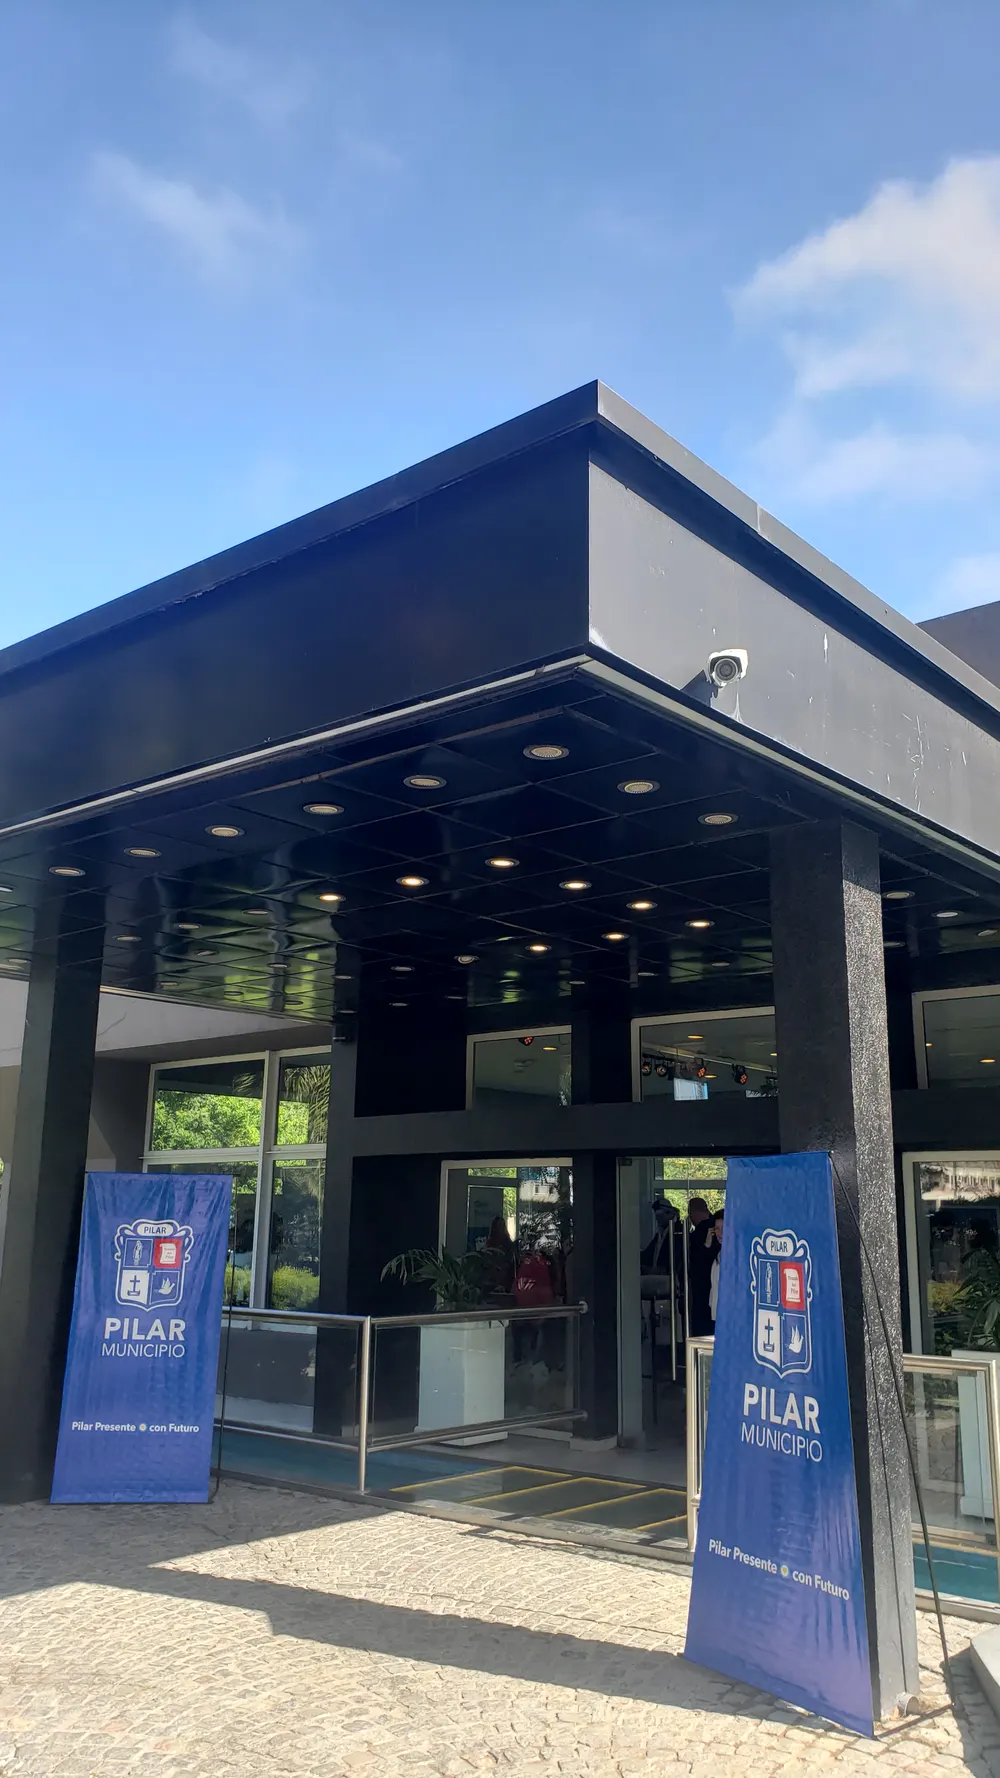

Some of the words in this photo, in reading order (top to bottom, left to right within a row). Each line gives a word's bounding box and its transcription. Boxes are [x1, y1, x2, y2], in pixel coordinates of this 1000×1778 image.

[144, 1226, 167, 1234] PILAR
[770, 1240, 788, 1253] PILAR
[104, 1317, 186, 1341] PILAR
[101, 1343, 185, 1358] MUNICIPIO
[743, 1383, 821, 1434] PILAR
[72, 1421, 93, 1431] Pilar
[95, 1422, 136, 1432] Presente
[168, 1424, 200, 1433] Futuro
[741, 1421, 823, 1462] MUNICIPIO
[708, 1539, 731, 1558] Pilar
[733, 1546, 778, 1574] Presente
[792, 1570, 812, 1587] con
[814, 1574, 850, 1600] Futuro
